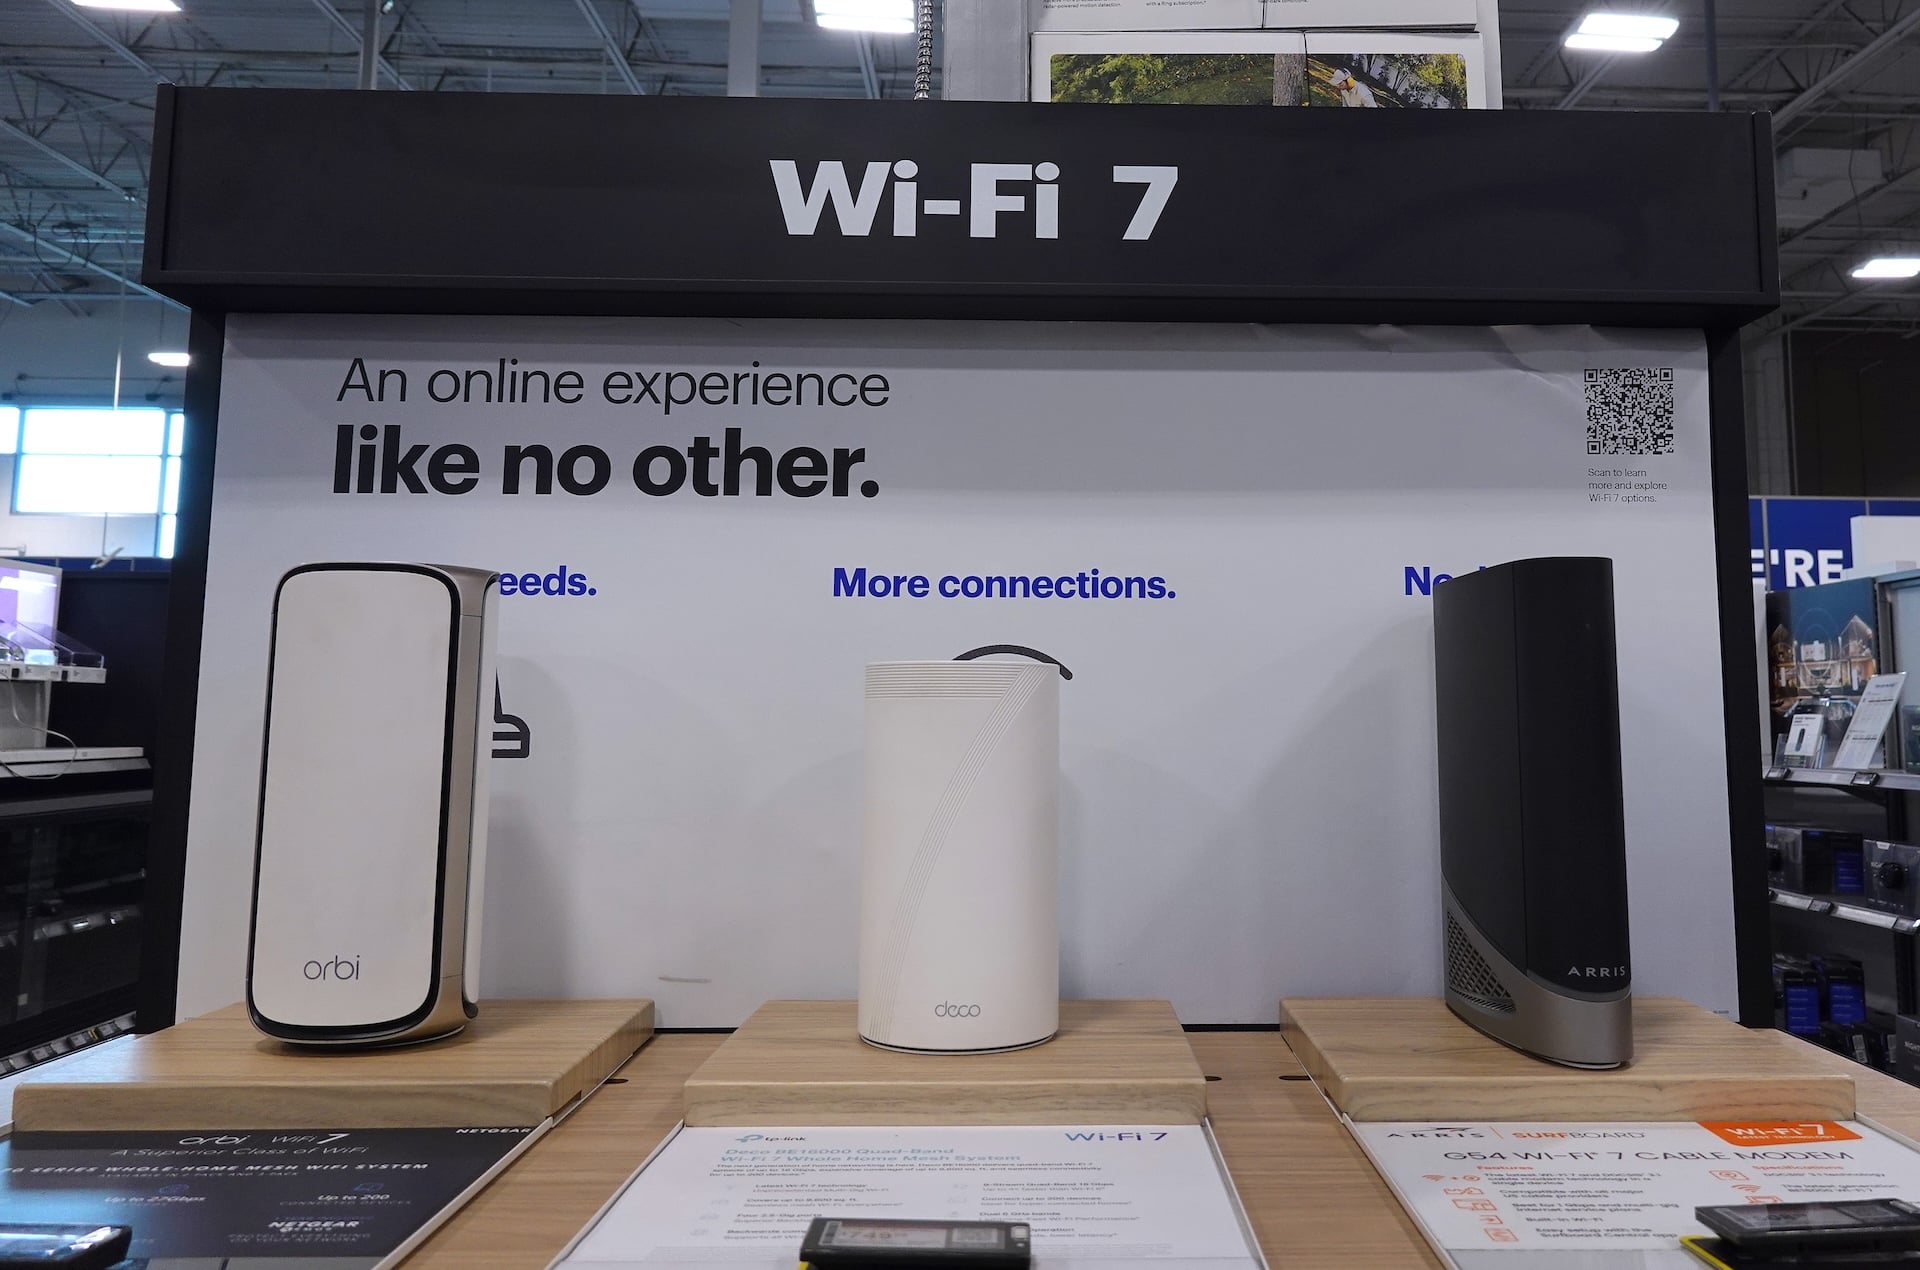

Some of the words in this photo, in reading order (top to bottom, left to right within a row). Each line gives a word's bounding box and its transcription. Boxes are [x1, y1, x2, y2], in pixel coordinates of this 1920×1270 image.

[769, 160, 1060, 239] Wi-Fi
[1112, 166, 1179, 242] 7
[337, 358, 407, 402] An
[427, 358, 584, 404] online
[602, 361, 890, 415] experience
[333, 424, 480, 495] like
[502, 444, 611, 496] no
[632, 428, 880, 498] other.
[1588, 468, 1610, 477] Scan
[1614, 469, 1622, 477] to
[1624, 468, 1646, 476] learn
[1614, 481, 1632, 490] and
[1634, 481, 1668, 491] explore
[1589, 493, 1611, 502] Wi-Fi
[1613, 493, 1619, 502] 7
[1621, 494, 1656, 504] options.
[1751, 549, 1843, 587] E'RE
[500, 566, 596, 596] eeds.
[833, 568, 929, 597] More
[938, 568, 1176, 600] connections.
[304, 954, 360, 980] orbi
[1568, 966, 1626, 977] ARRIS
[934, 1000, 980, 1018] deco
[1800, 1124, 1825, 1136] 7
[179, 1134, 250, 1144] orbi
[316, 1134, 350, 1144] 7
[1065, 1132, 1142, 1142] Wi-Fi
[1150, 1132, 1168, 1142] 7
[134, 1148, 228, 1156] Superior
[1444, 1152, 1506, 1160] G54
[1606, 1152, 1623, 1160] 7
[1635, 1152, 1731, 1160] CABLE
[1734, 1151, 1855, 1160] MODEM
